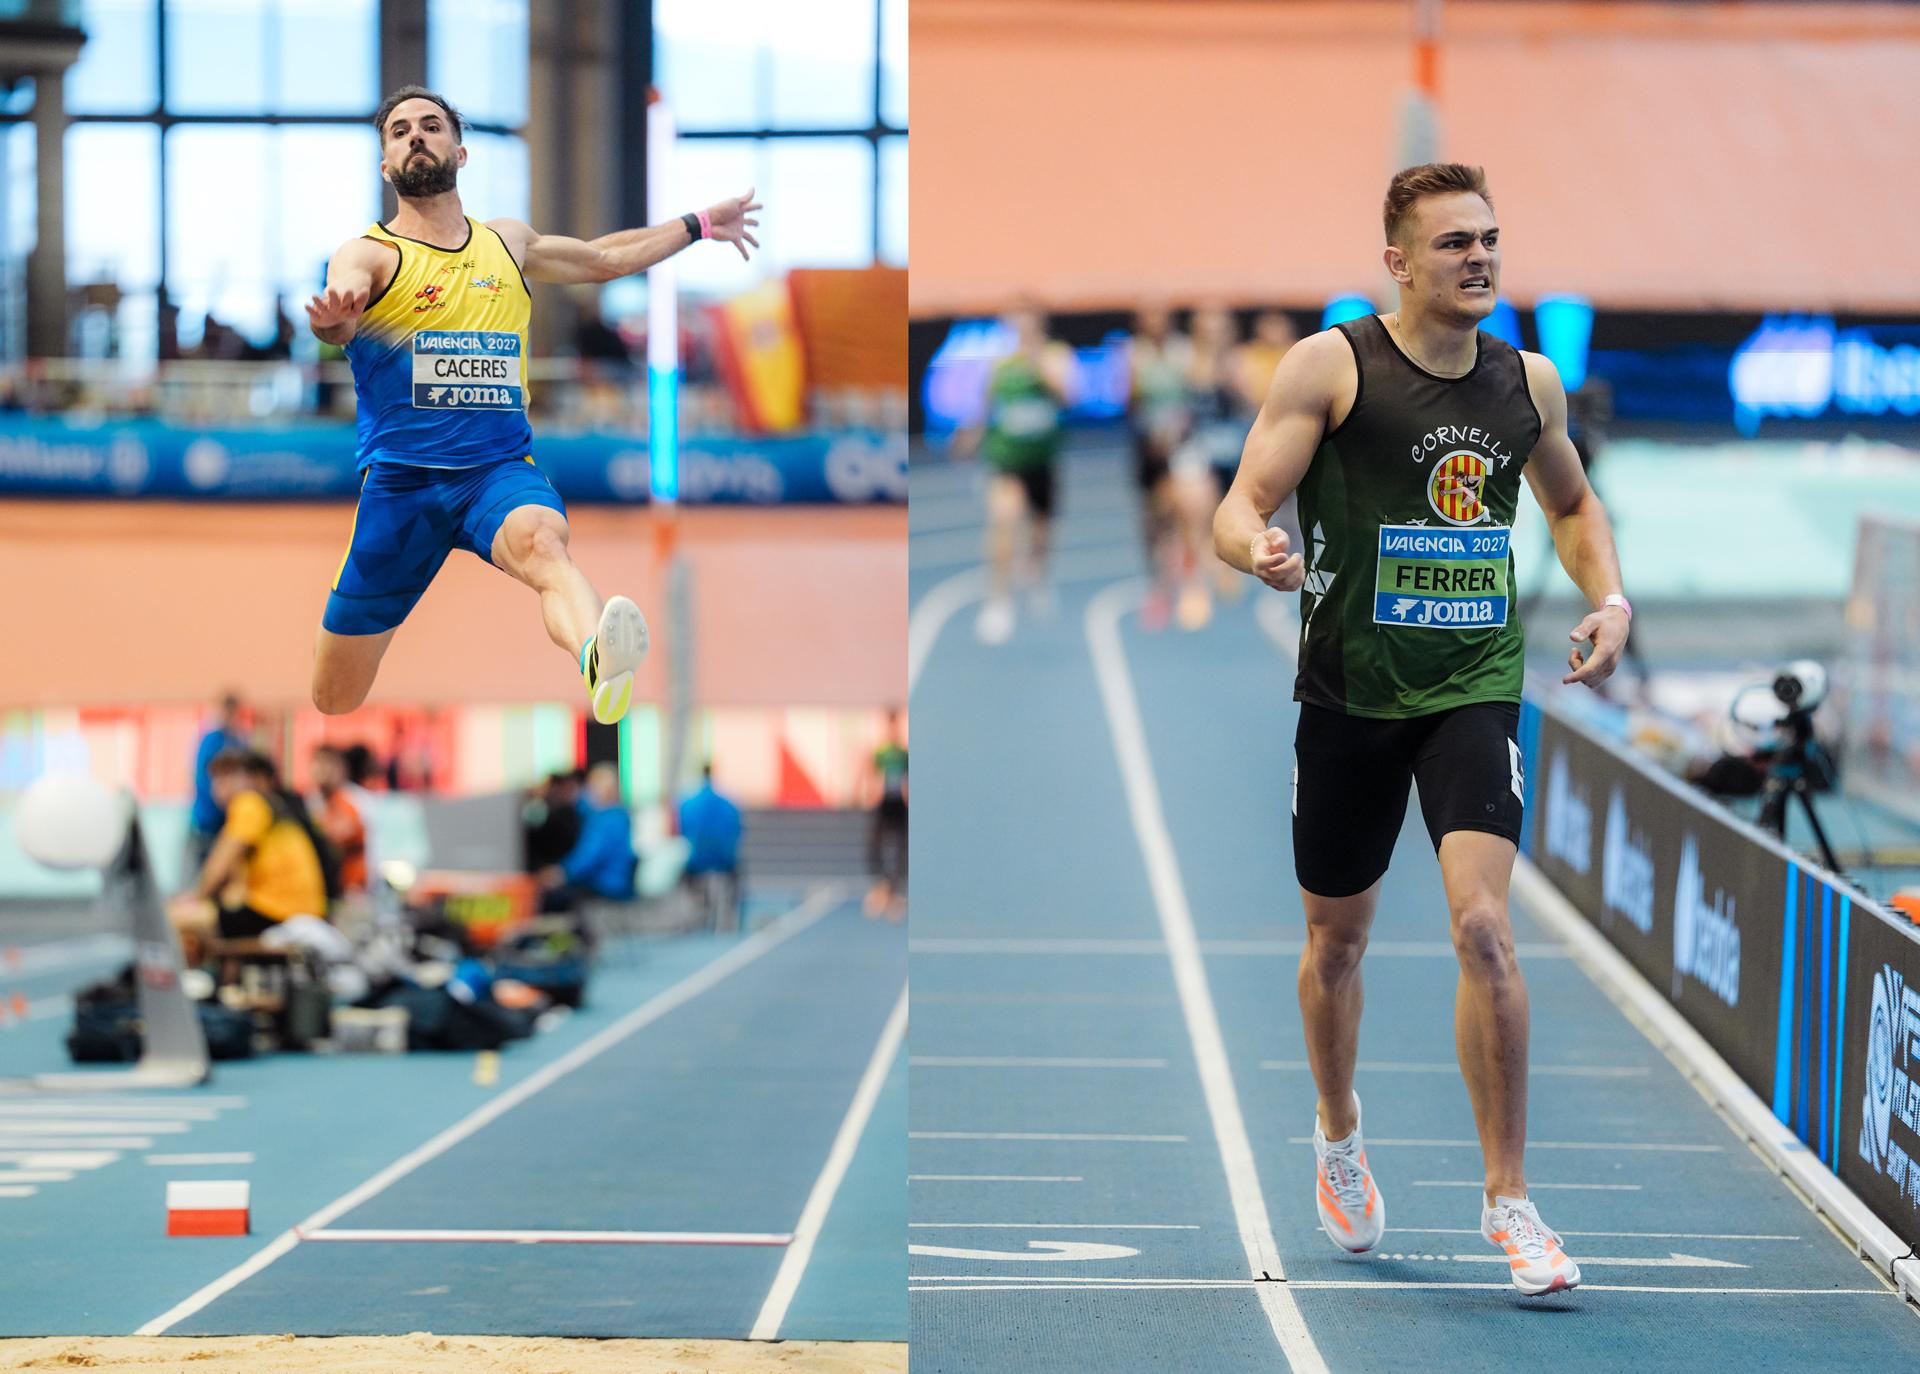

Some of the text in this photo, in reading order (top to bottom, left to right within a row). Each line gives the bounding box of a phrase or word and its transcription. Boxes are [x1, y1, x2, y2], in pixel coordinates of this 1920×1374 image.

[420, 337, 517, 351] VALENCIA 2027
[434, 358, 507, 378] CACERES
[447, 386, 513, 406] Joma
[1385, 535, 1506, 553] VALENCIA 2027
[1395, 564, 1496, 592] FERRER
[1417, 600, 1494, 624] Joma
